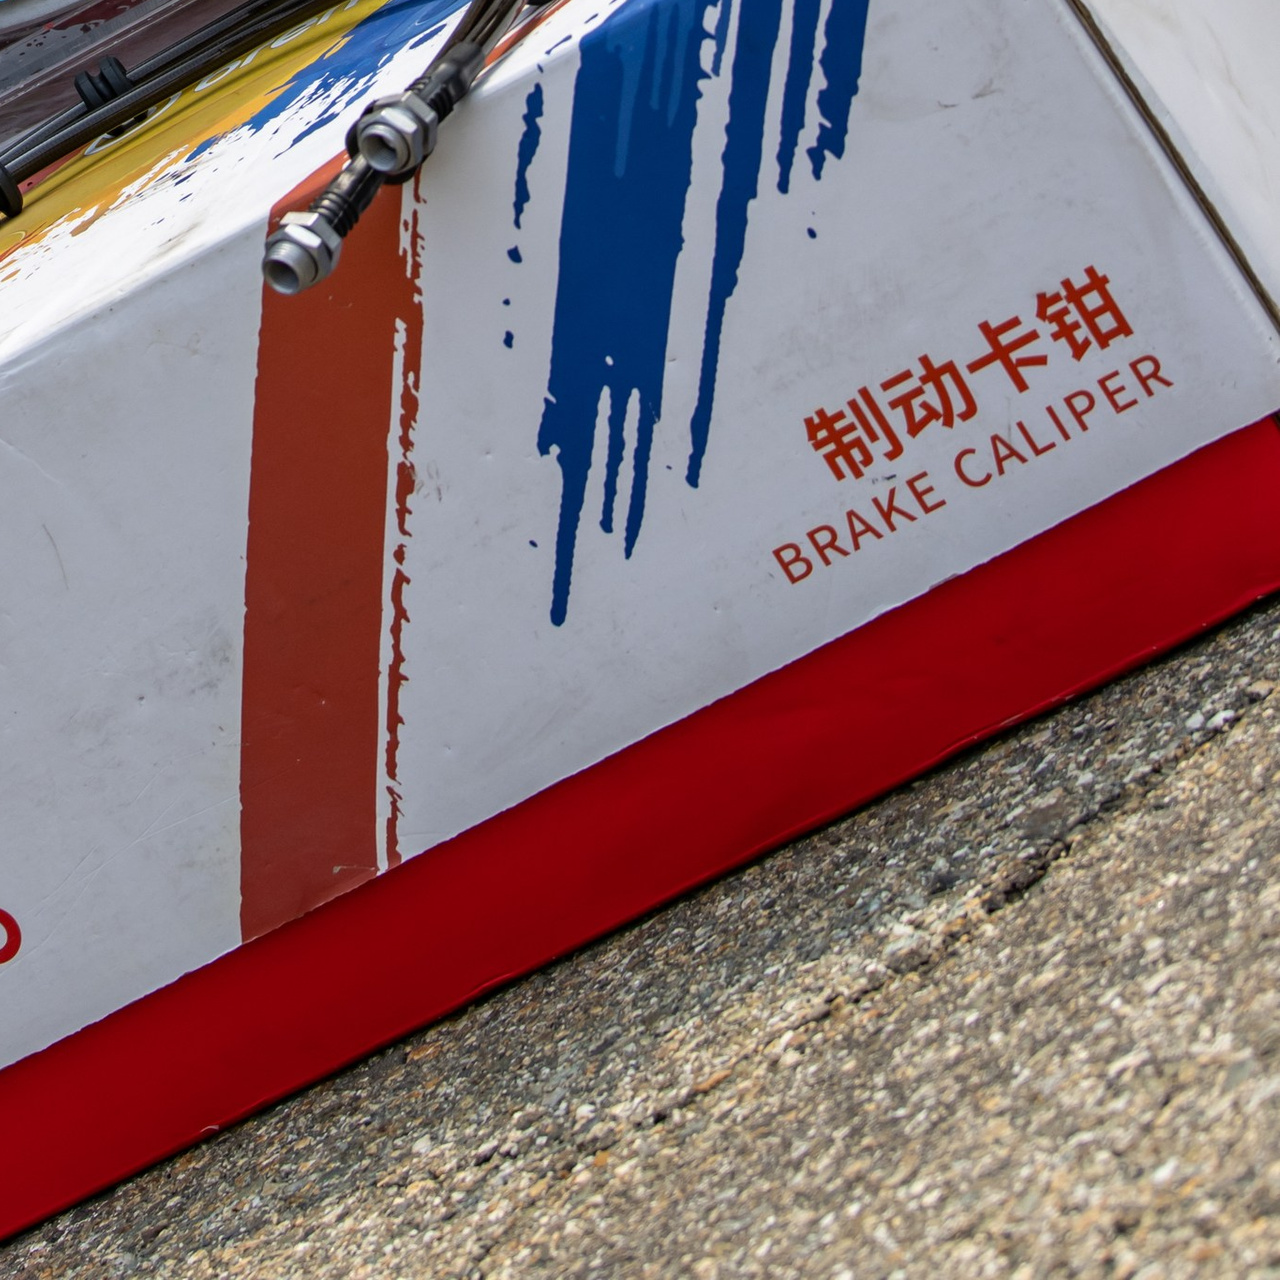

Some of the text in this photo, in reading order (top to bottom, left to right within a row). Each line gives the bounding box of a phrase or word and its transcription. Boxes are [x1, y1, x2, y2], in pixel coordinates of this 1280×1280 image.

[771, 354, 1174, 585] BRAKE CALIPER
[803, 264, 1134, 482] 制动卡钳
